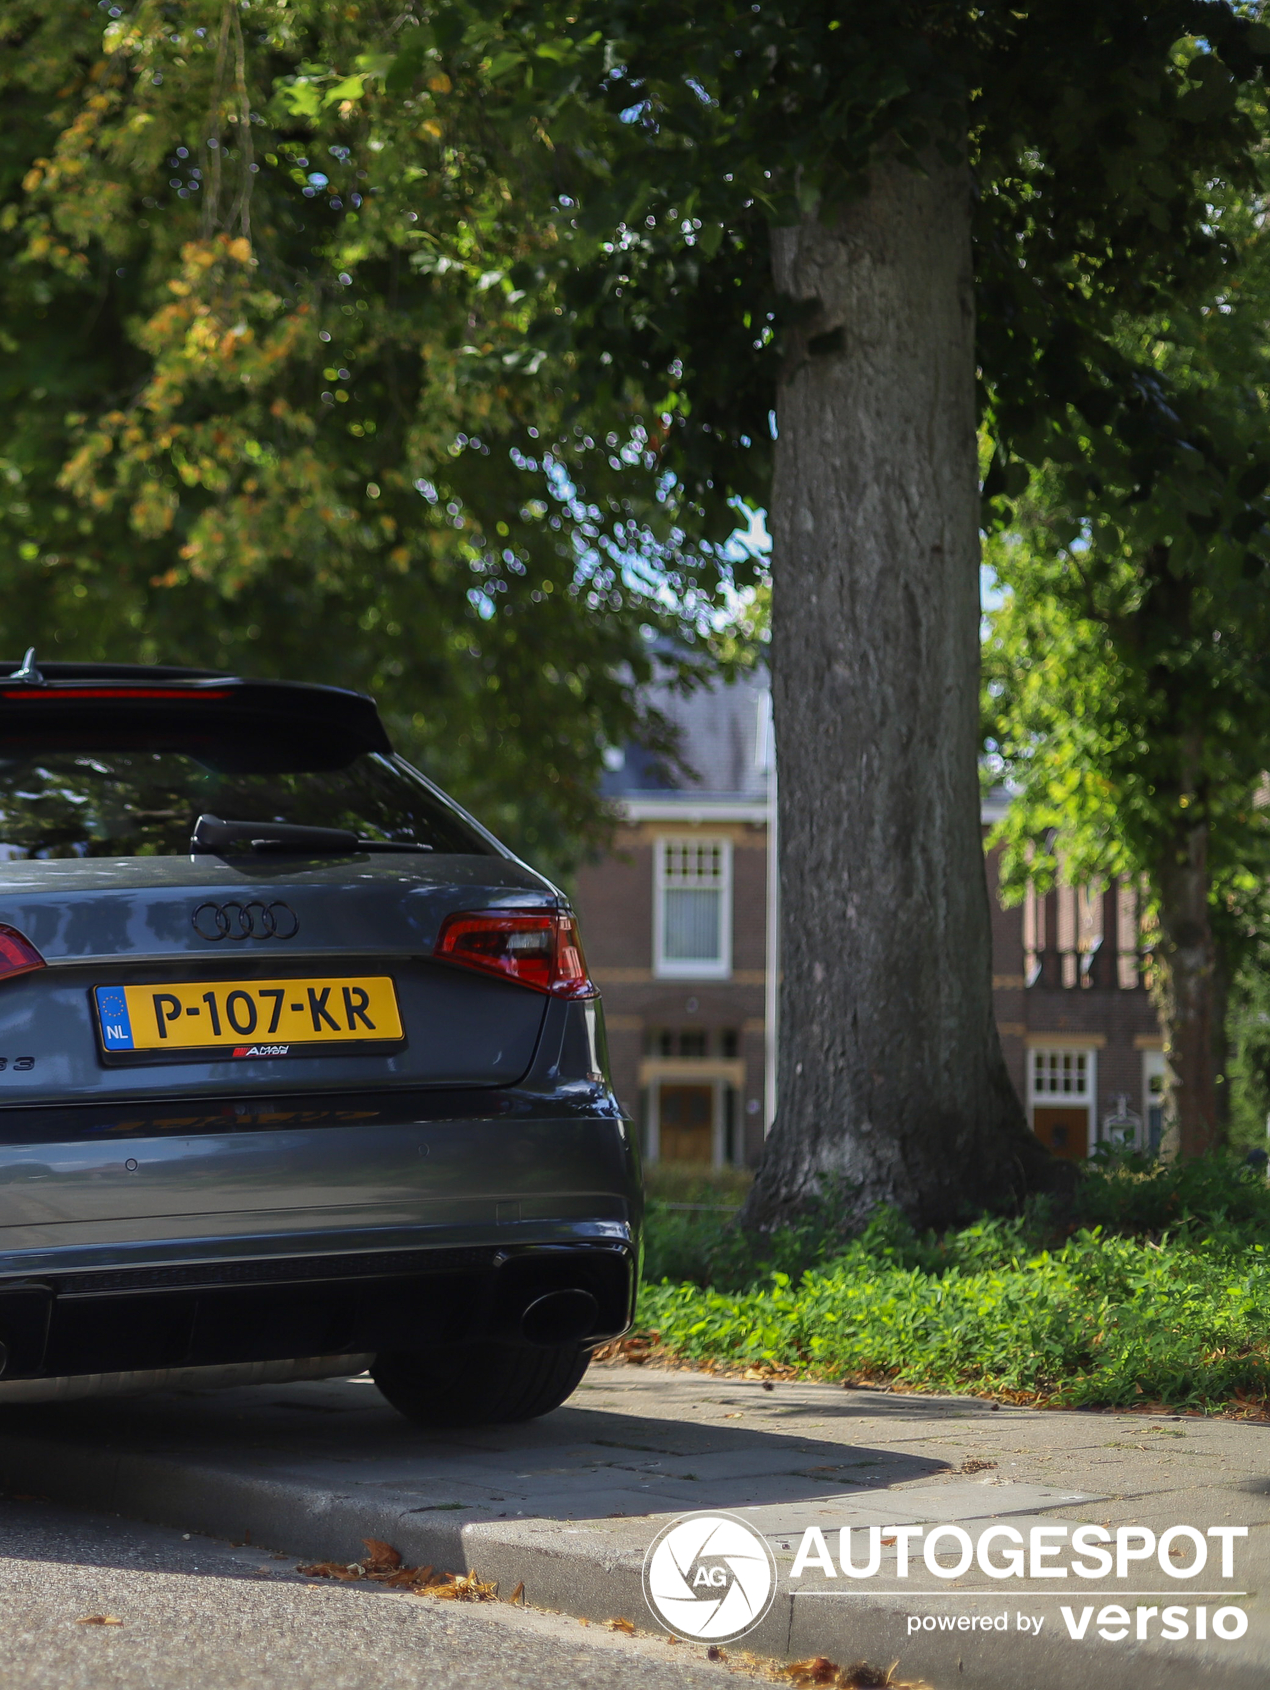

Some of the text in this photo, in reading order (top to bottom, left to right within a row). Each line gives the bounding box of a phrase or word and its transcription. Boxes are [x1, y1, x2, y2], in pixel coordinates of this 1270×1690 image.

[152, 987, 376, 1039] P-107-KR
[106, 1025, 129, 1040] NL
[13, 1056, 35, 1071] 3
